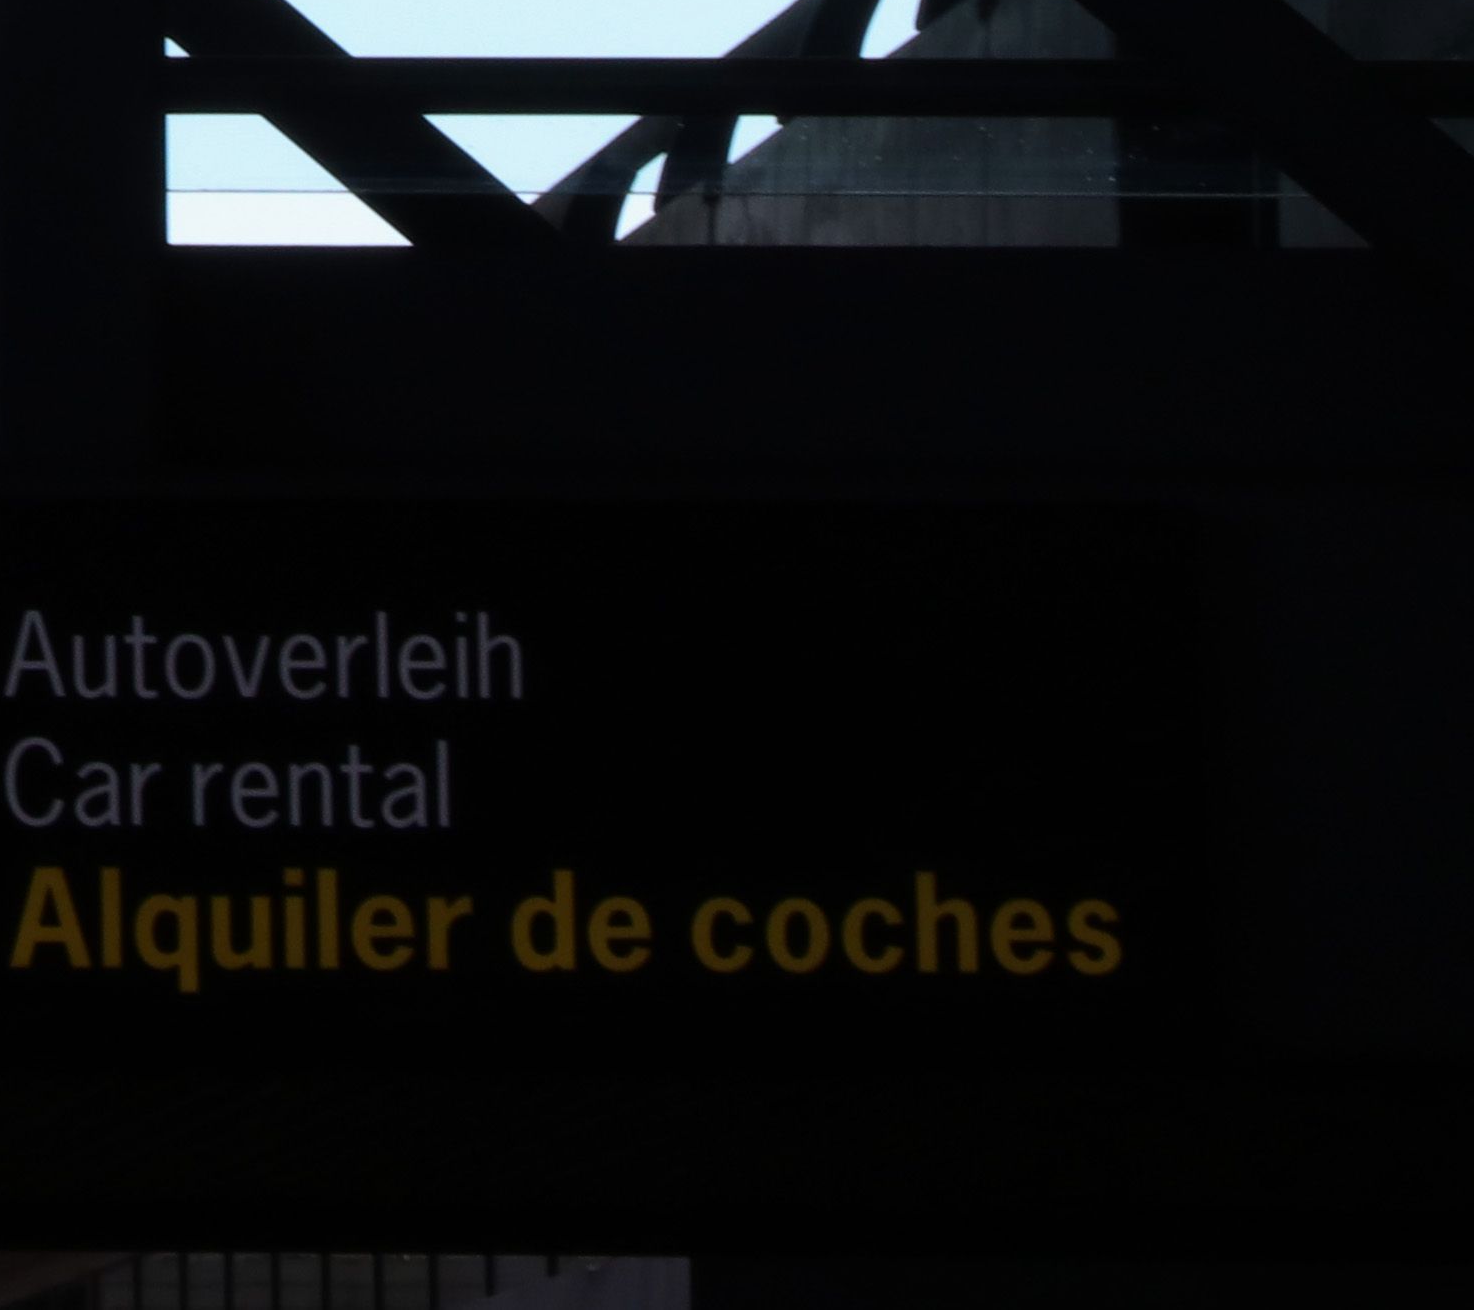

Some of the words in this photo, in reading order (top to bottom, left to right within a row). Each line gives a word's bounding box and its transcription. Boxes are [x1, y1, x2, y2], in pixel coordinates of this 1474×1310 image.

[5, 610, 521, 700] Autoverleih
[5, 737, 161, 827] Car
[193, 740, 449, 828] rental
[11, 868, 471, 992] Alquiler
[512, 870, 651, 971] de
[692, 873, 1121, 974] coches
